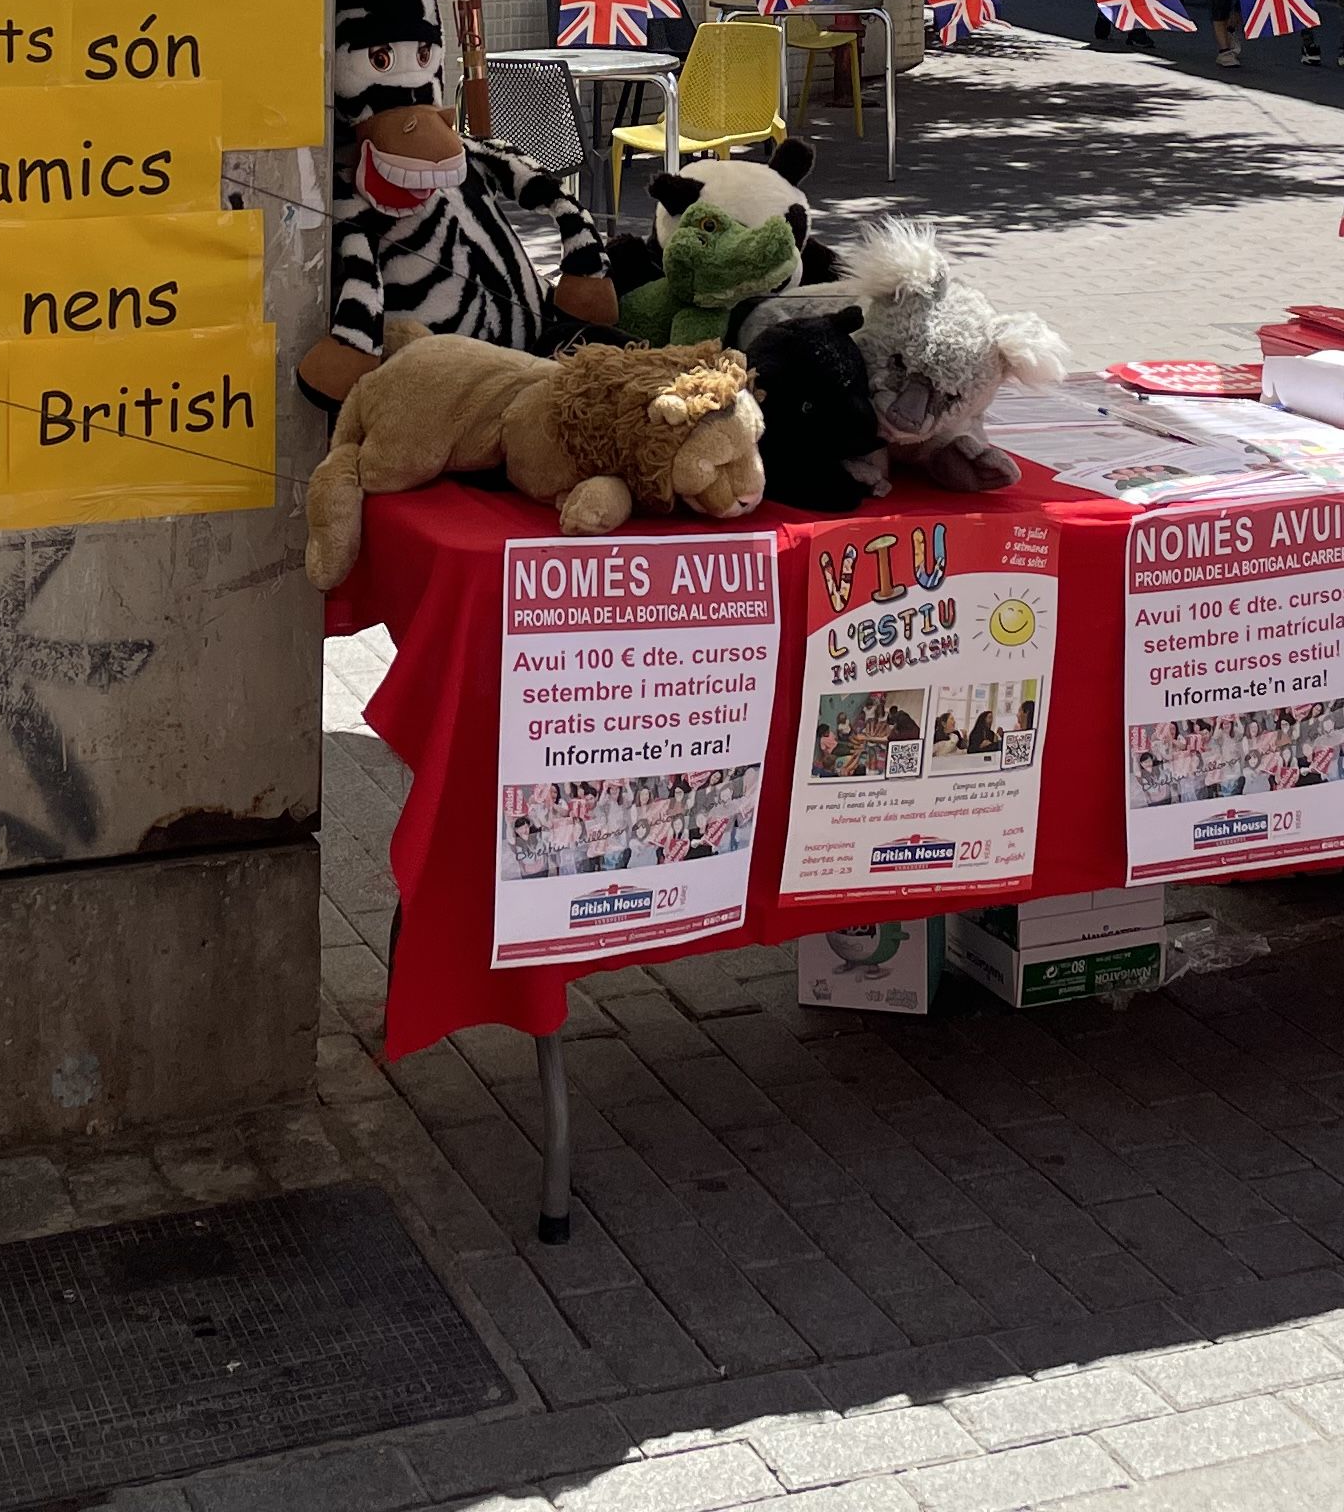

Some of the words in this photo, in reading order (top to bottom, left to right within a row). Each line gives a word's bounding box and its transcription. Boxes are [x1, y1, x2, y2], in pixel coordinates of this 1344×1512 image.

[86, 14, 201, 80] són
[23, 280, 178, 334] nens
[39, 375, 254, 446] British
[1136, 510, 1253, 564] NOMÉS
[515, 547, 650, 600] NOMÉS
[672, 552, 765, 595] AVUI!
[819, 523, 946, 613] VIU
[1135, 569, 1181, 587] PROMO
[1184, 566, 1204, 582] DIA
[1206, 565, 1222, 581] DE
[1225, 562, 1241, 578] LA
[1242, 556, 1284, 576] BOTIGA
[1285, 555, 1300, 569] AL
[514, 609, 565, 627] PROMO
[568, 607, 591, 625] DIA
[594, 606, 613, 624] DE
[616, 605, 634, 623] LA
[637, 602, 688, 623] BOTIGA
[690, 604, 706, 620] AL
[709, 601, 768, 619] CARRER!
[1135, 606, 1181, 627] Avui
[1188, 600, 1223, 620] 100
[1228, 598, 1241, 616] €
[1247, 595, 1283, 614] dte.
[1144, 629, 1240, 653] setembre
[1246, 625, 1251, 642] i
[513, 650, 565, 672] Avui
[574, 647, 613, 669] 100
[621, 647, 635, 667] €
[643, 646, 684, 666] dte.
[692, 643, 767, 665] cursos
[831, 660, 858, 686] IN
[865, 633, 960, 678] ENGLISH!
[1150, 660, 1208, 685] gratis
[1215, 654, 1281, 674] cursos
[1288, 640, 1340, 663] estiu!
[522, 682, 632, 704] setembre
[641, 681, 646, 700] i
[654, 673, 757, 697] matrícula
[1292, 670, 1327, 691] ara!
[528, 715, 595, 740] gratis
[604, 712, 680, 732] cursos
[688, 703, 747, 726] estiu!
[690, 735, 731, 757] ara!
[1195, 824, 1229, 838] British
[1233, 820, 1266, 833] House
[1273, 812, 1293, 831] 20
[873, 850, 911, 862] British
[916, 847, 953, 859] House
[959, 840, 982, 861] 20
[571, 901, 610, 916] British
[614, 897, 651, 913] House
[656, 887, 677, 909] 20
